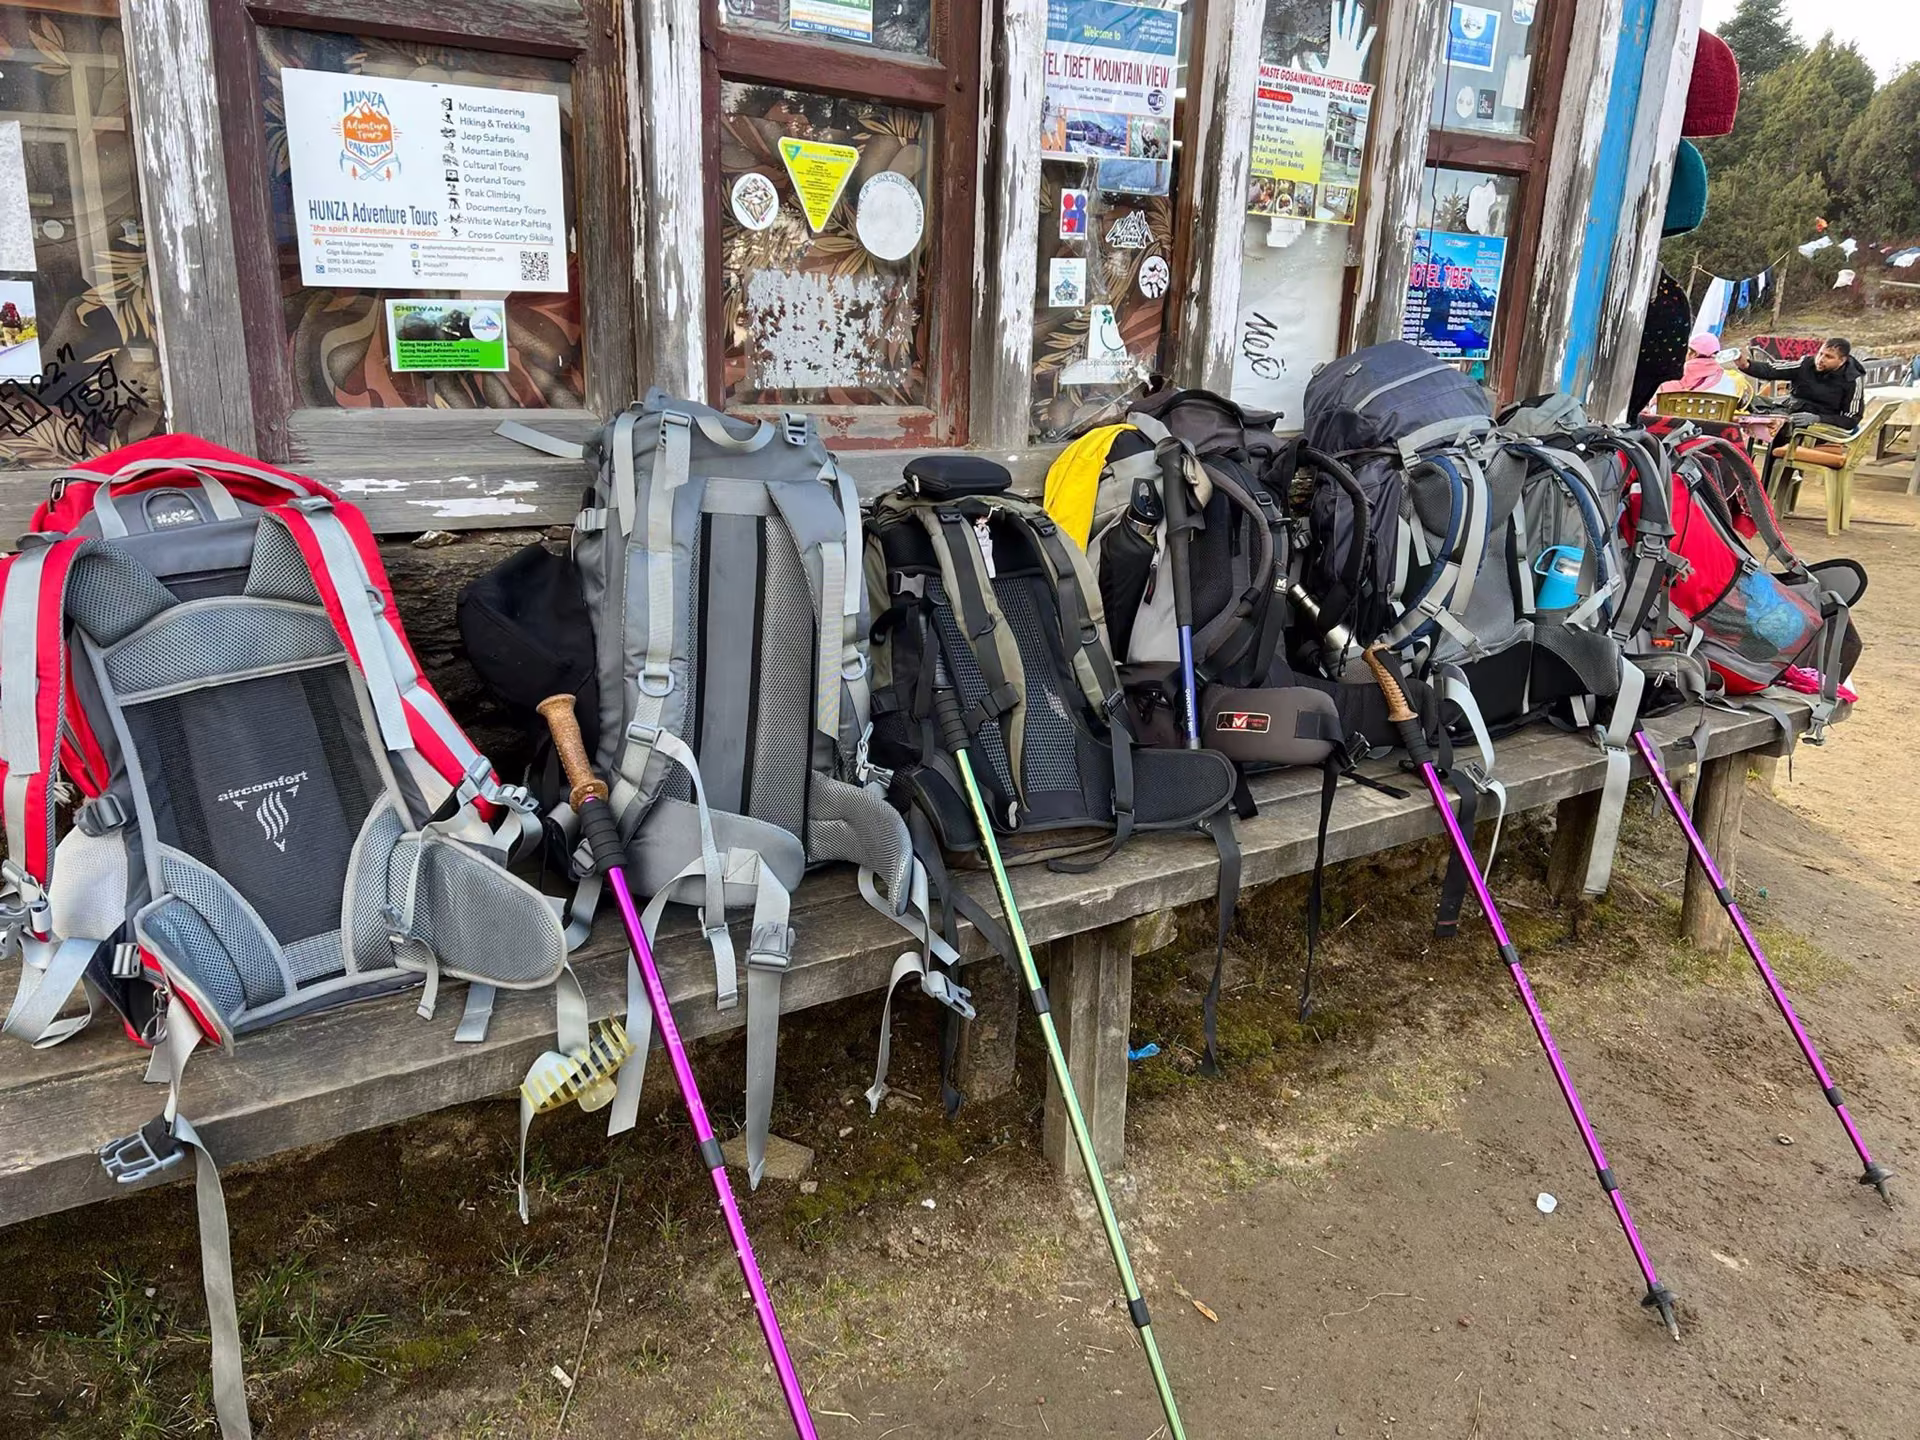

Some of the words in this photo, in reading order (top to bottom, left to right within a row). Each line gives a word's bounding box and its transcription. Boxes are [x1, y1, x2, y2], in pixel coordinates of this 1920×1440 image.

[1083, 25, 1112, 40] Welcome
[1113, 30, 1121, 40] to
[1064, 54, 1091, 80] TIBET
[1093, 58, 1143, 85] MOUNTAIN
[1145, 64, 1170, 89] VIEW
[1280, 68, 1325, 87] GOSAINKUNDA
[1326, 79, 1344, 92] HOTEL
[1344, 82, 1350, 93] &
[1350, 82, 1372, 96] LODGE
[344, 90, 390, 115] HUNZA
[458, 102, 525, 118] Mountaineering
[346, 120, 388, 130] Adventure
[460, 116, 486, 129] Hiking
[487, 120, 494, 128] &
[496, 120, 530, 132] Trekking
[357, 130, 383, 140] Tours
[460, 132, 482, 144] Jeep
[483, 133, 515, 144] Safaris
[348, 140, 390, 158] PAKISTAN
[462, 146, 503, 157] Mountain
[504, 149, 529, 160] Biking
[463, 160, 497, 170] Cultural
[498, 162, 522, 172] Tours
[464, 174, 501, 184] Overland
[502, 176, 526, 186] Tours
[465, 188, 484, 198] Peak
[486, 190, 521, 202] Climbing
[308, 199, 350, 222] HUNZA
[352, 202, 407, 225] Adventure
[408, 205, 439, 227] Tours
[466, 202, 522, 214] Documentary
[524, 206, 547, 215] Tours
[467, 216, 492, 226] White
[494, 218, 520, 228] Water
[520, 218, 552, 230] Rafting
[328, 225, 348, 234] spirit
[350, 226, 358, 234] of
[360, 226, 398, 236] adventure
[398, 228, 404, 236] &
[468, 230, 494, 239] Cross
[494, 232, 528, 242] Country
[1443, 265, 1473, 291] TIBET
[1184, 688, 1192, 716] QUECHUA
[218, 770, 309, 802] aircomfort
